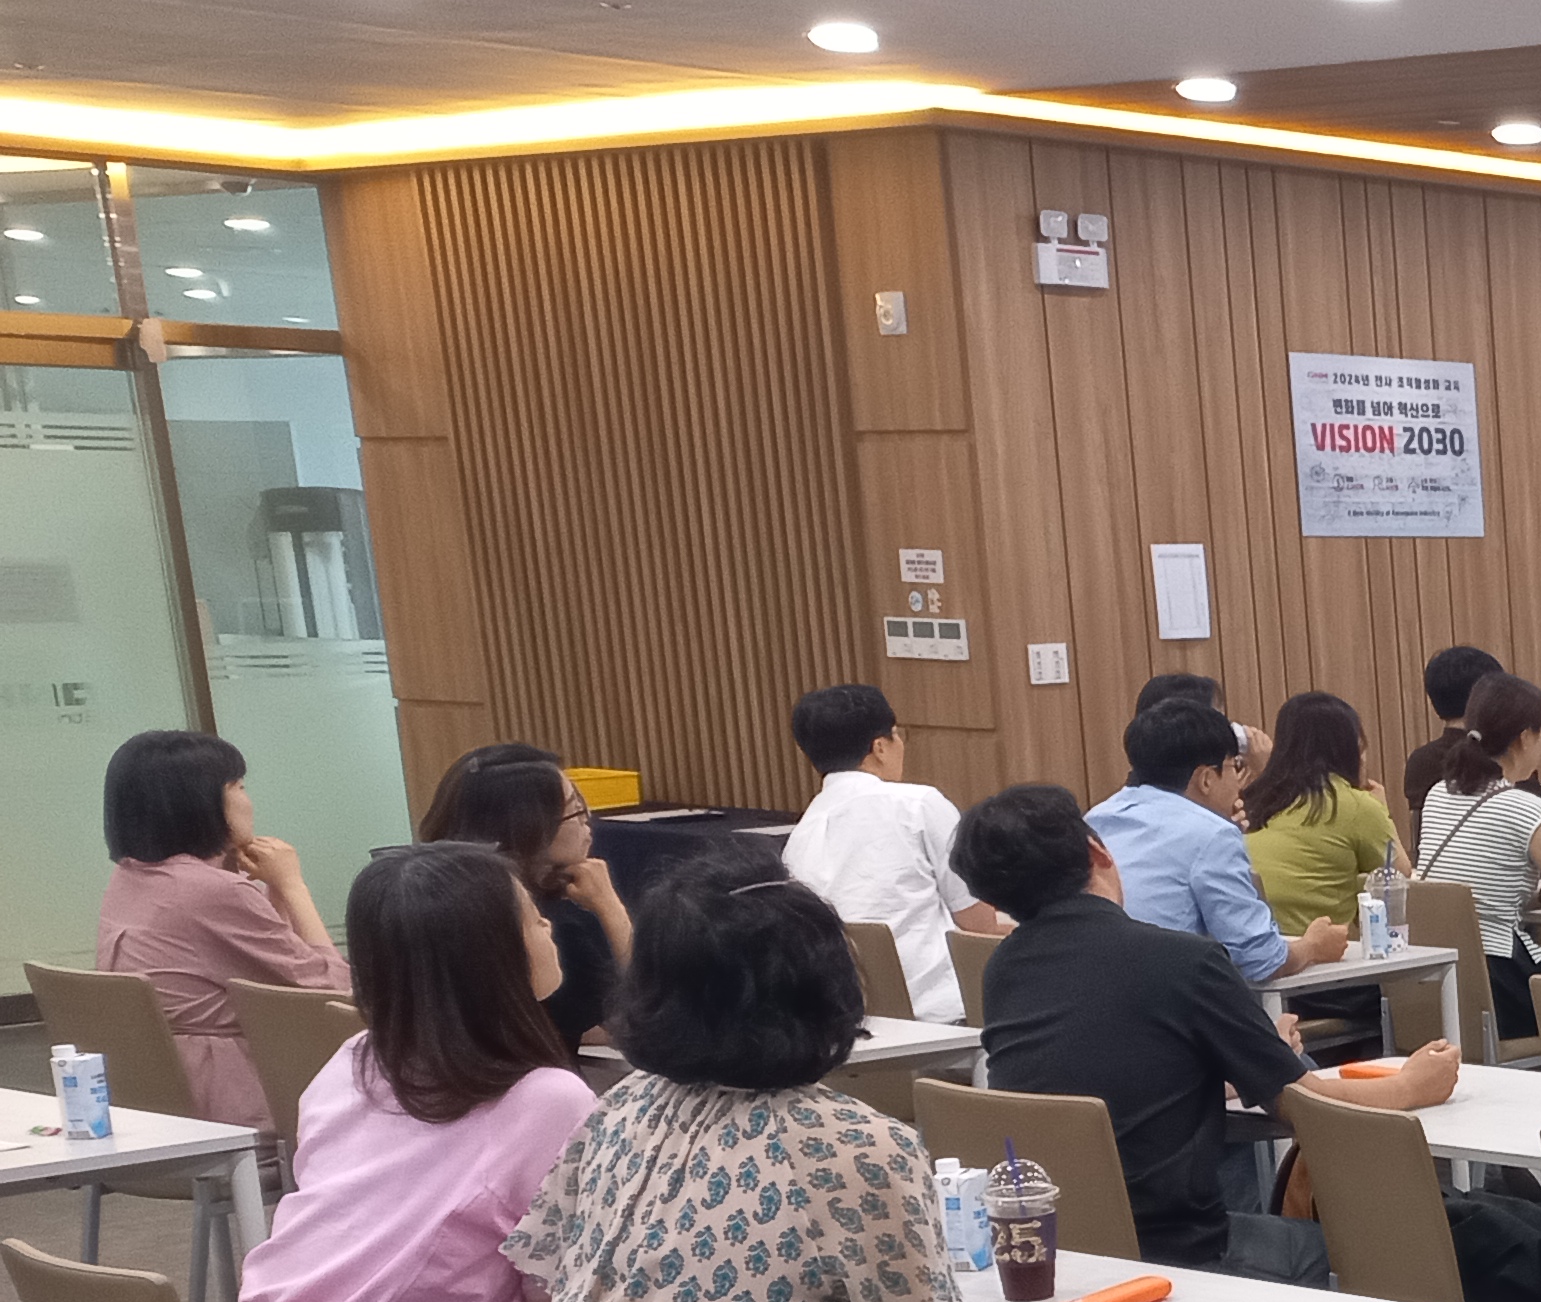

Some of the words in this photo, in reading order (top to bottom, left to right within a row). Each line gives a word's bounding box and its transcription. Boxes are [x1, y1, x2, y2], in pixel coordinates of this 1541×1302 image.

[1332, 398, 1366, 416] 변화를
[1370, 400, 1394, 417] 넘어
[1397, 401, 1441, 419] 혁신으로
[1310, 422, 1395, 457] VISION
[1402, 426, 1465, 457] 2030
